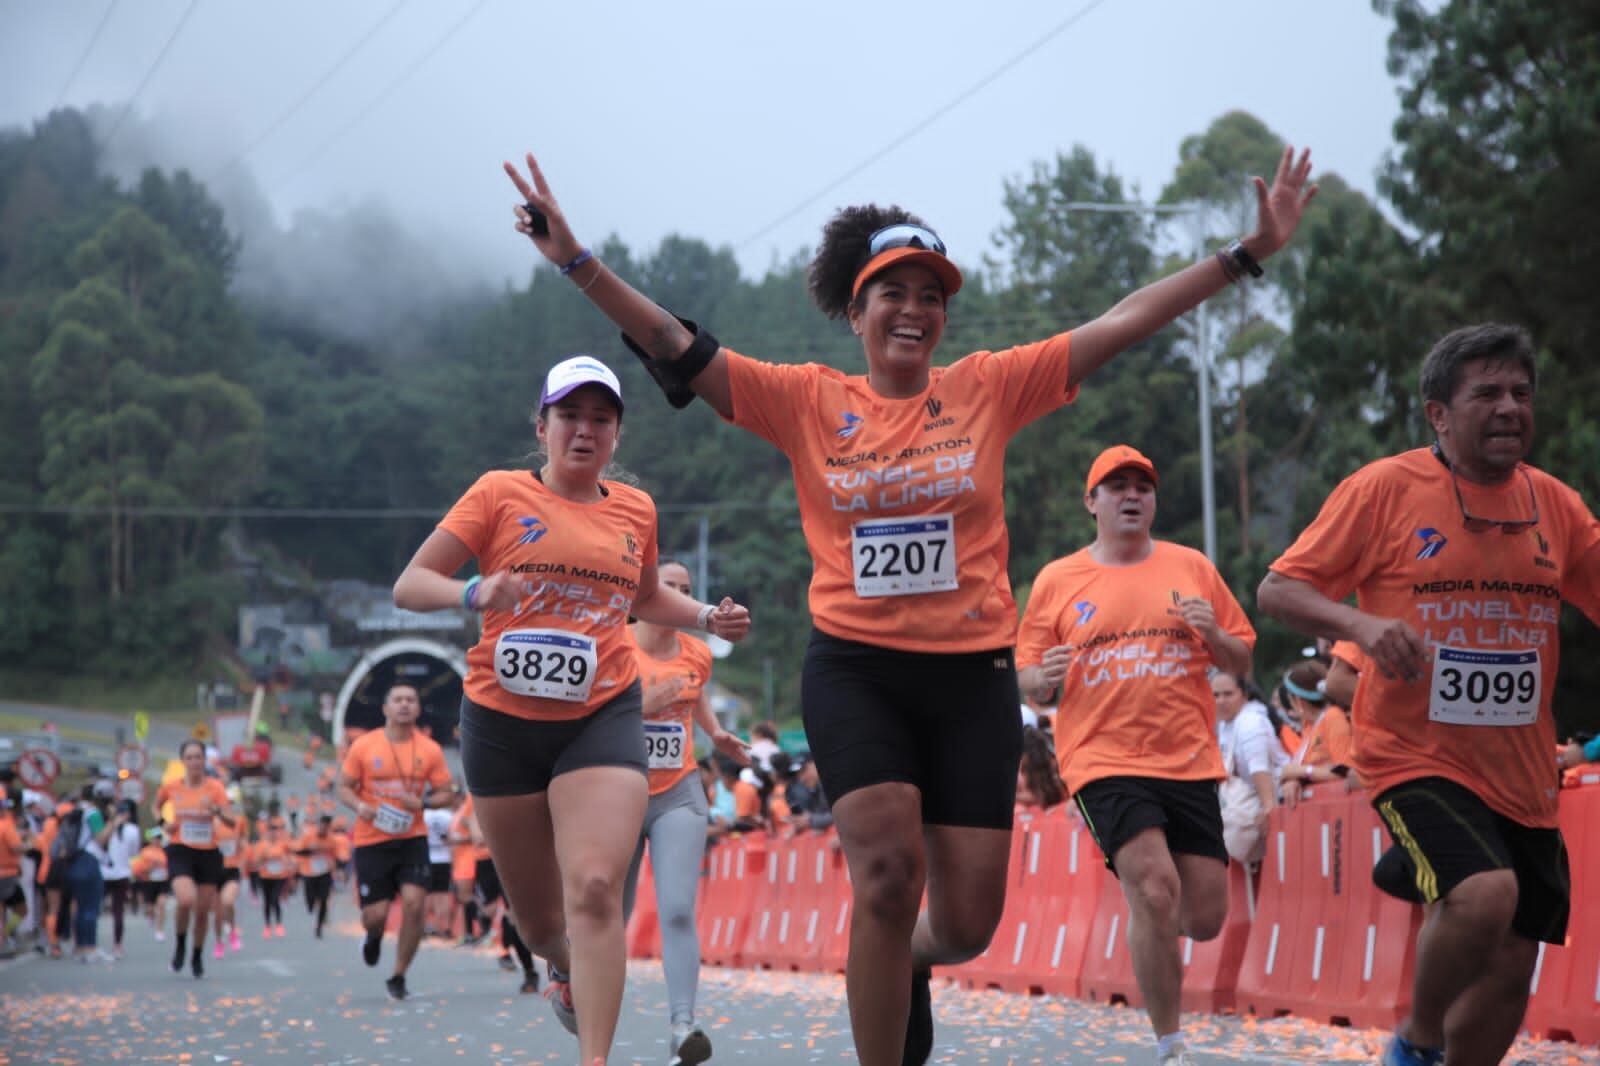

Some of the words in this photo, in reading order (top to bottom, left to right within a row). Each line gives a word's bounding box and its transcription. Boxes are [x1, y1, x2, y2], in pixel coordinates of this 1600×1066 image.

[825, 451, 877, 467] MEDIA
[825, 464, 927, 489] TÚNEL
[934, 450, 977, 474] DE
[832, 493, 869, 512] LA
[879, 475, 977, 508] LÍNEA
[510, 563, 566, 575] MEDIA
[859, 538, 947, 578] 2207
[1413, 580, 1475, 595] MEDIA
[1416, 595, 1522, 621] TÚNEL
[1528, 604, 1558, 624] DE
[1424, 627, 1468, 647] LA
[500, 647, 588, 687] 3829
[1083, 667, 1113, 688] LA
[1439, 667, 1536, 704] 3099
